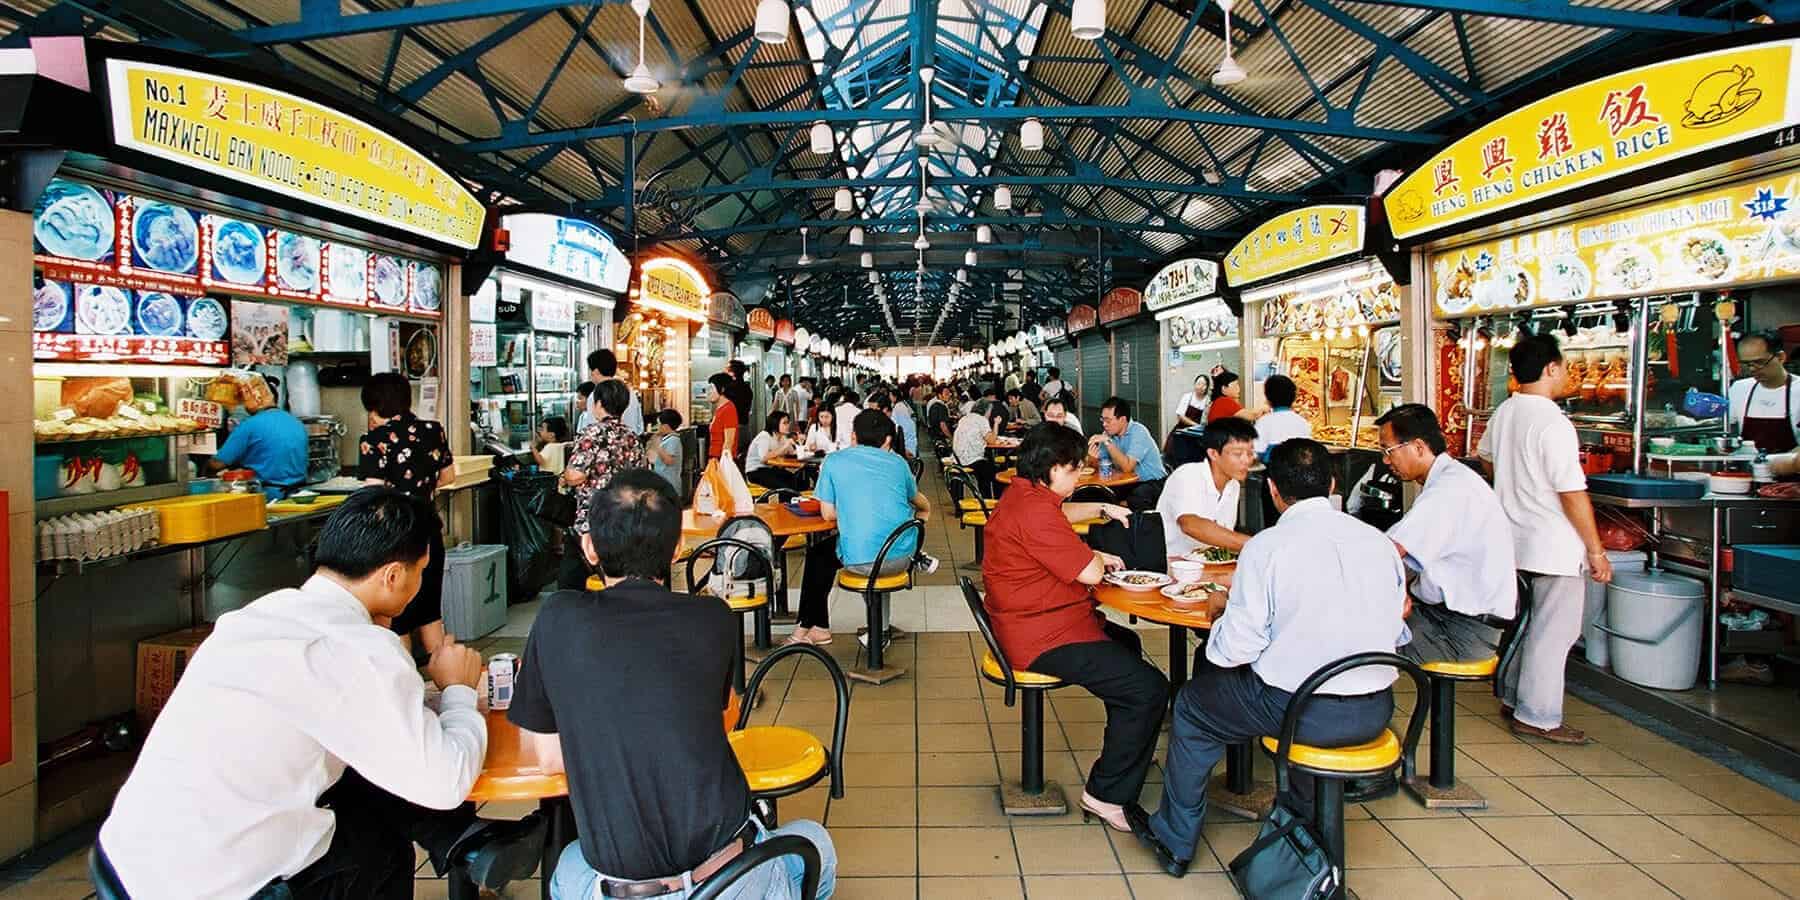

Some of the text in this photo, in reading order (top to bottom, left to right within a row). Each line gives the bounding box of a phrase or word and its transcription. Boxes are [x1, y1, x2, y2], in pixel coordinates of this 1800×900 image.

[145, 79, 187, 105] No.1
[143, 107, 221, 161] MAXWELL
[227, 136, 255, 171] BAN
[1775, 127, 1795, 146] 44
[1432, 125, 1670, 217] HENG HENG CHICKEN RICE
[498, 303, 517, 313] sub
[484, 561, 501, 604] 1
